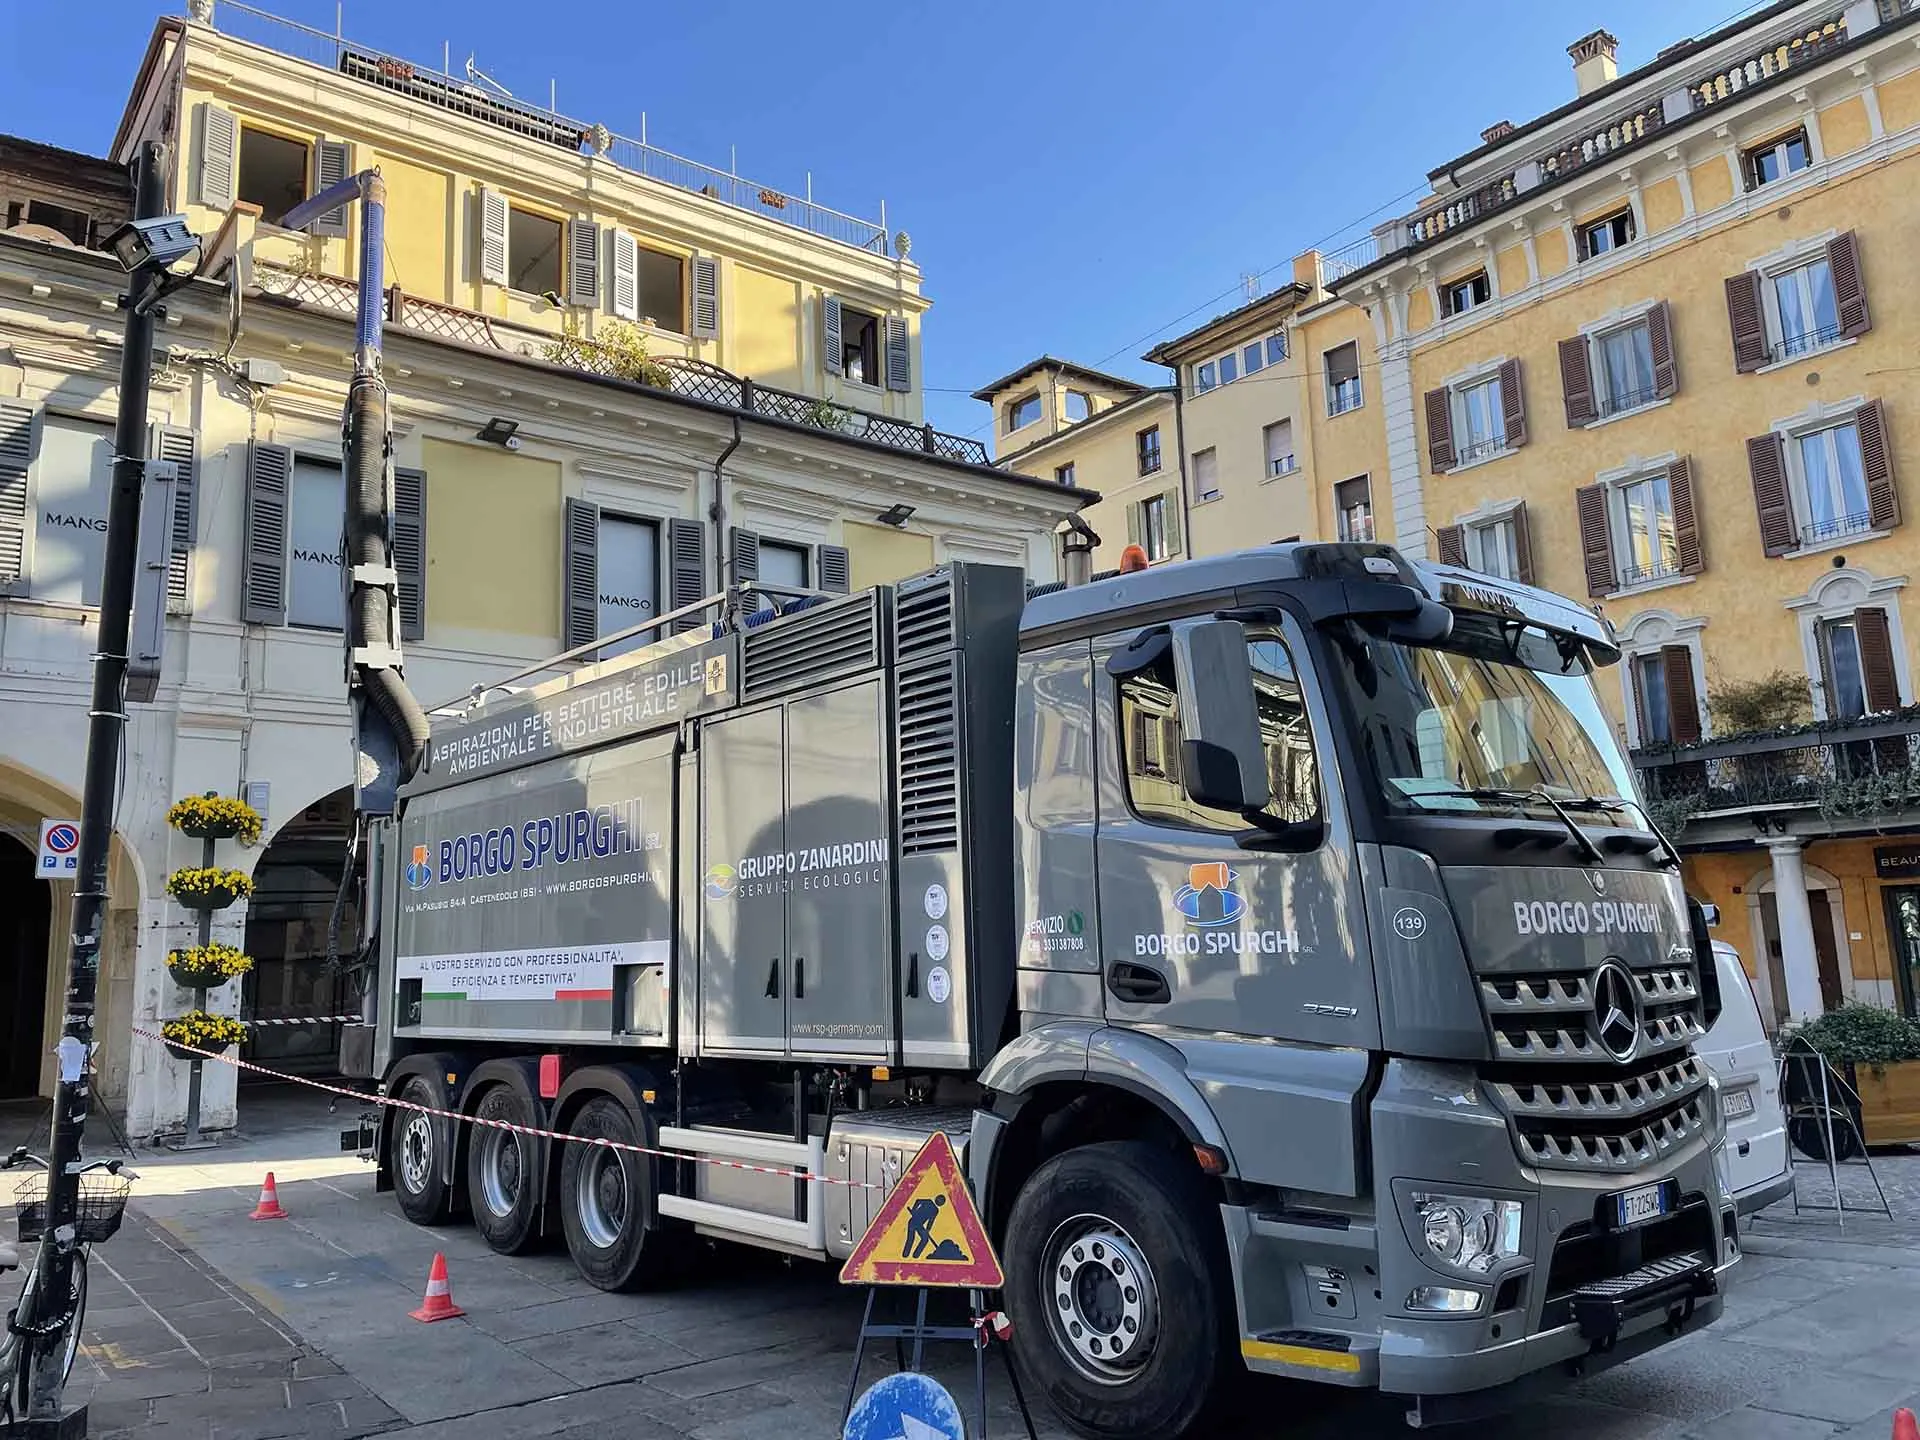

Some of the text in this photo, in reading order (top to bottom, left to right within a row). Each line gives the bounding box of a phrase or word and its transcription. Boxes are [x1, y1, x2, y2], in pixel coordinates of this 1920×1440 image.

[599, 594, 651, 609] MANGO
[432, 721, 517, 766] ASPIRAZIONI
[523, 711, 553, 736] PER
[559, 682, 636, 723] SETTORE
[449, 692, 678, 775] AMBIENTALE E INDUSTRIALE
[439, 825, 516, 884] BORGO
[521, 797, 641, 870] SPURGHI
[738, 838, 888, 880] GRUPPO ZANARDINI
[1881, 855, 1920, 867] BEAU
[545, 870, 663, 895] WWW.BORGOSPURGHI.IT
[739, 867, 888, 898] SERVIZI ECOLOGICI
[1025, 915, 1064, 934] SERVIZIO
[1397, 917, 1422, 929] 139
[1513, 901, 1663, 934] BORGO SPURGHI
[1134, 933, 1200, 956] BORGO
[1205, 930, 1300, 955] SPURGHI
[420, 962, 429, 971] AL
[431, 959, 461, 971] VOSTRO
[464, 957, 501, 969] SERVIZIO
[504, 956, 523, 967] CON
[452, 976, 498, 987] EFFICIENZA
[501, 975, 507, 985] E
[792, 1023, 884, 1038] www.rsp-germany.com
